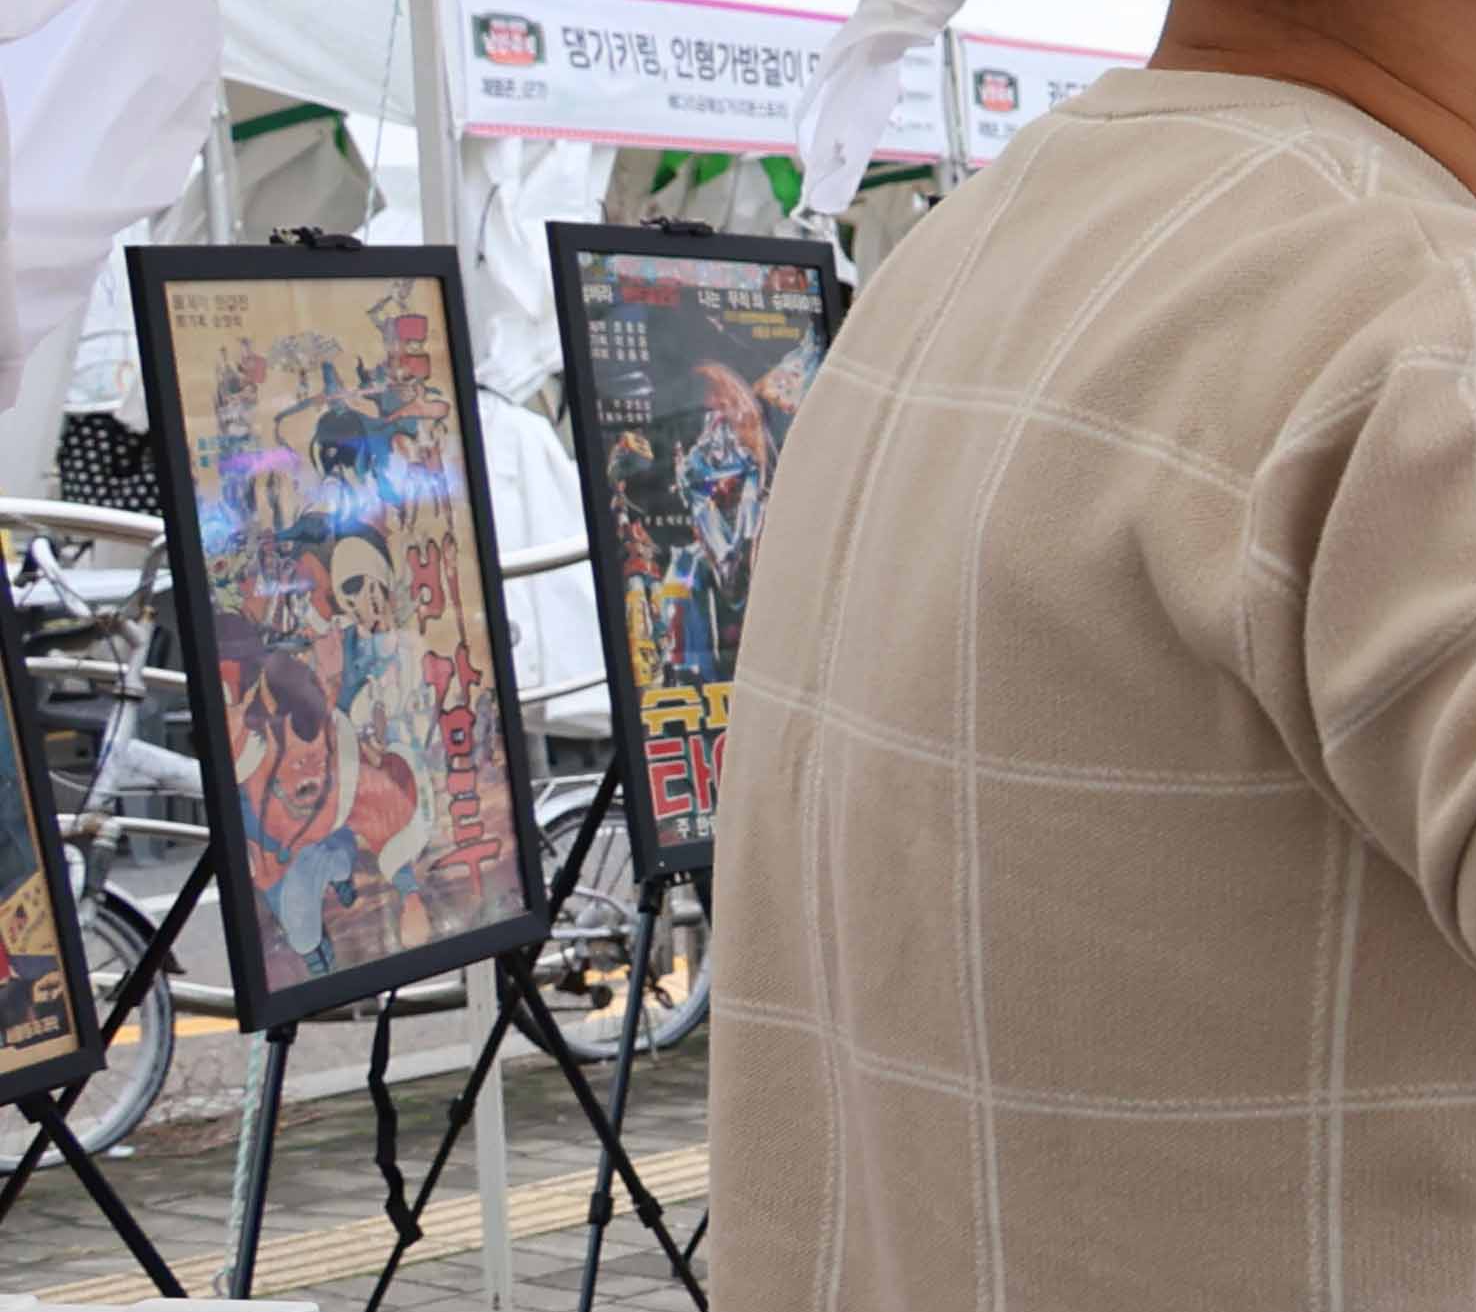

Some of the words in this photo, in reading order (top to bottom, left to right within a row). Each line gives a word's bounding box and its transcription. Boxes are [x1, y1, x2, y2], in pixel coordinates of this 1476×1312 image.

[561, 26, 668, 79] 댕기키링,
[670, 35, 806, 87] 인형가방걸이
[645, 732, 730, 821] 타
